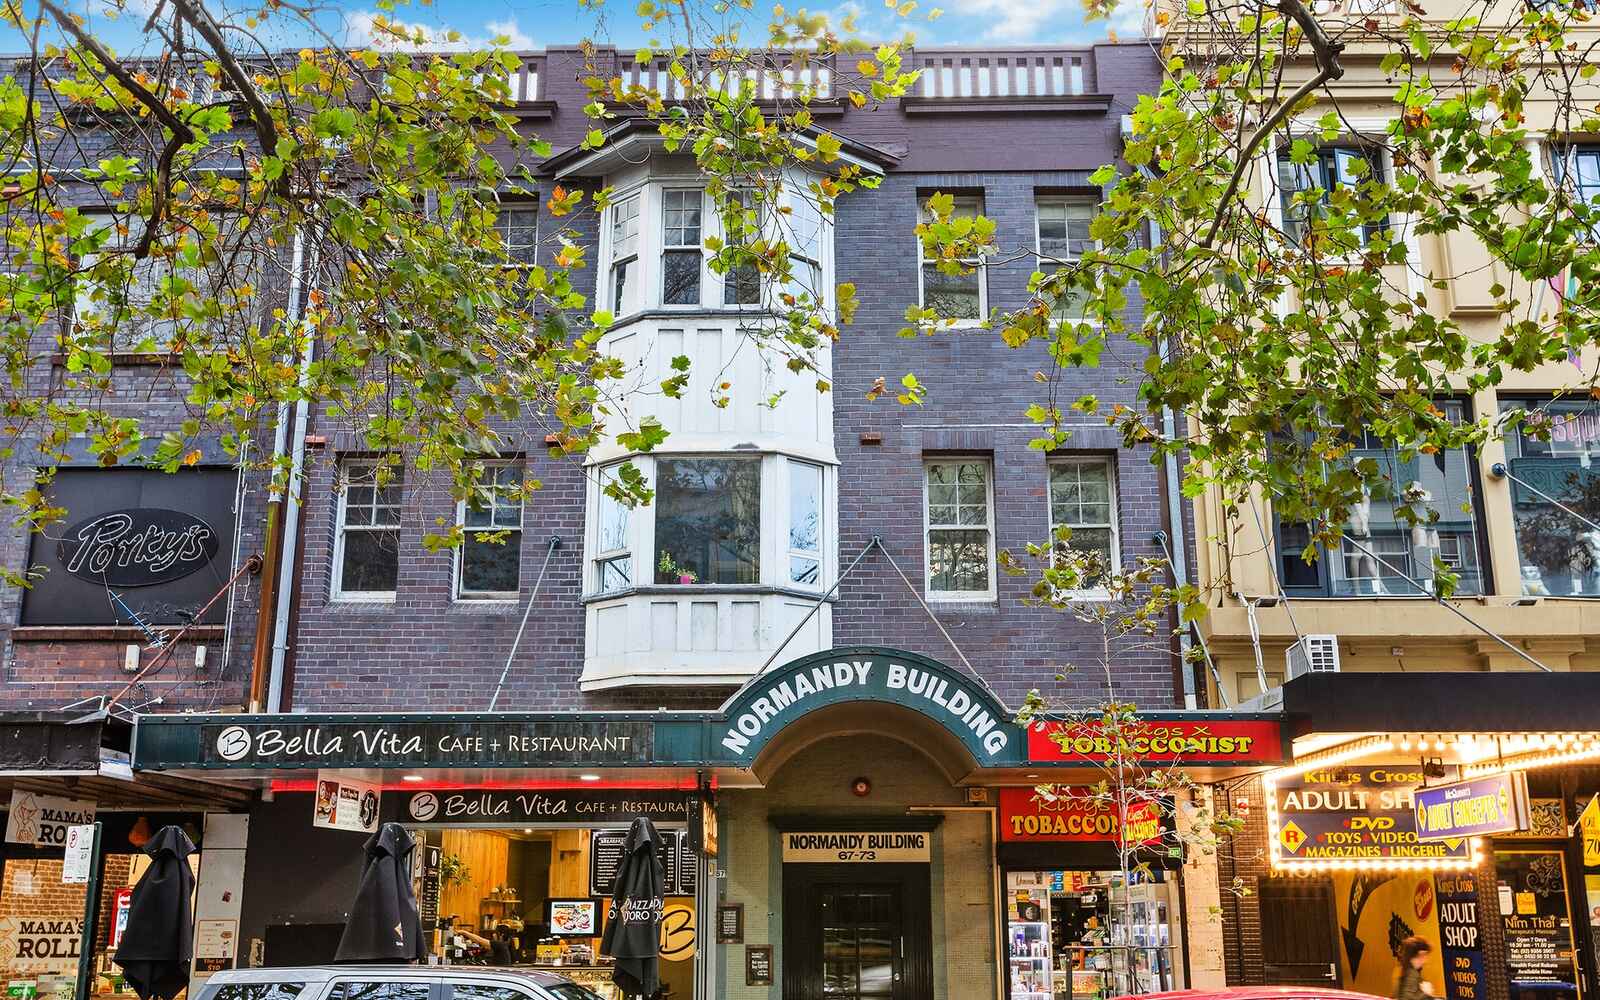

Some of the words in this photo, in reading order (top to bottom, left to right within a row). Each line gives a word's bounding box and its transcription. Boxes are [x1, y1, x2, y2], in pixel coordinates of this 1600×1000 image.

[67, 513, 209, 573] Porky's
[721, 661, 873, 755] NORMANDY
[886, 664, 1009, 756] BUILDING
[256, 729, 343, 756] Bella
[353, 728, 423, 755] Vita
[508, 735, 631, 752] RESTAURANT
[1056, 737, 1253, 754] TOBACCONIST
[1369, 769, 1424, 784] Cross
[445, 795, 510, 816] Bella
[516, 793, 568, 816] Vita
[622, 801, 690, 813] RESTAURA
[1283, 791, 1370, 810] ADULT
[1379, 790, 1415, 810] SH
[41, 808, 93, 825] MAMA'S
[1350, 816, 1396, 832] DVD
[789, 834, 864, 850] NORMANDY
[868, 833, 925, 850] BUILDING
[1285, 830, 1299, 843] R
[1325, 831, 1362, 844] TOYS
[1371, 831, 1419, 844] VIDEO
[838, 850, 876, 861] 67-73
[1305, 846, 1381, 858] MAGAZINES
[1390, 845, 1446, 858] LINGERIE
[1441, 903, 1476, 924] ADULT
[1505, 915, 1528, 929] Nim
[1530, 914, 1555, 929] Thai
[1445, 926, 1478, 948] SHOP
[1455, 956, 1471, 968] DVD
[1453, 971, 1478, 985] VIDEOS
